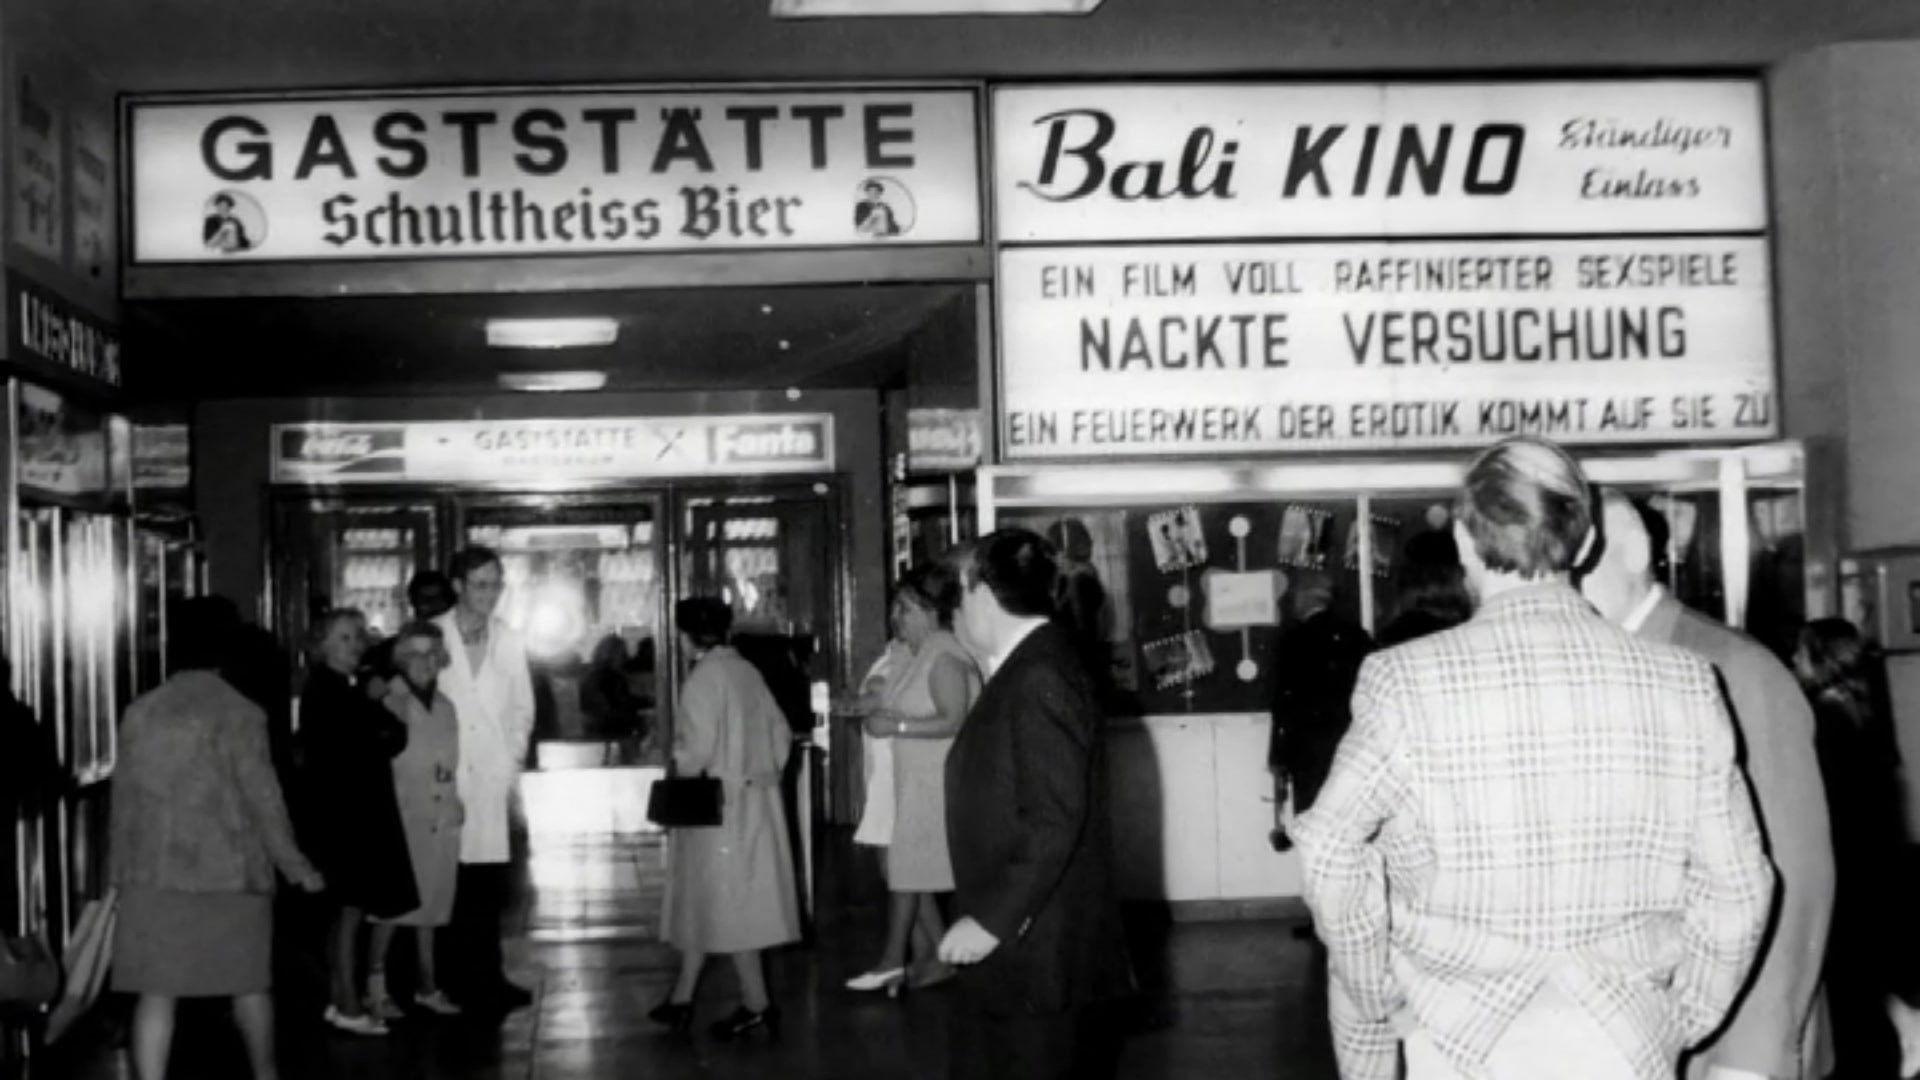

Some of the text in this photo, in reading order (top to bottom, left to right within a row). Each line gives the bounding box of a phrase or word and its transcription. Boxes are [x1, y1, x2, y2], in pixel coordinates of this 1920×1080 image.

[200, 103, 915, 182] GASTSTÄTTE
[1016, 108, 1526, 202] Bali KINO
[1580, 168, 1702, 200] Einlass
[322, 184, 803, 246] Schultheiss Bier
[1041, 253, 1738, 298] EIN FILM VOLL RAFFINIERTER SEXSPIELE
[1079, 305, 1687, 371] NACKTE VERSUCHUNG
[715, 425, 816, 464] Fanta
[1010, 412, 1058, 446] EIN
[1072, 405, 1262, 445] FEUERWERK
[1278, 404, 1334, 440] DER
[1350, 400, 1459, 438] EROTIK
[1479, 397, 1588, 436] KOMMT
[1600, 396, 1655, 432] AUF
[1671, 394, 1716, 429] SIE
[1734, 391, 1770, 429] ZU
